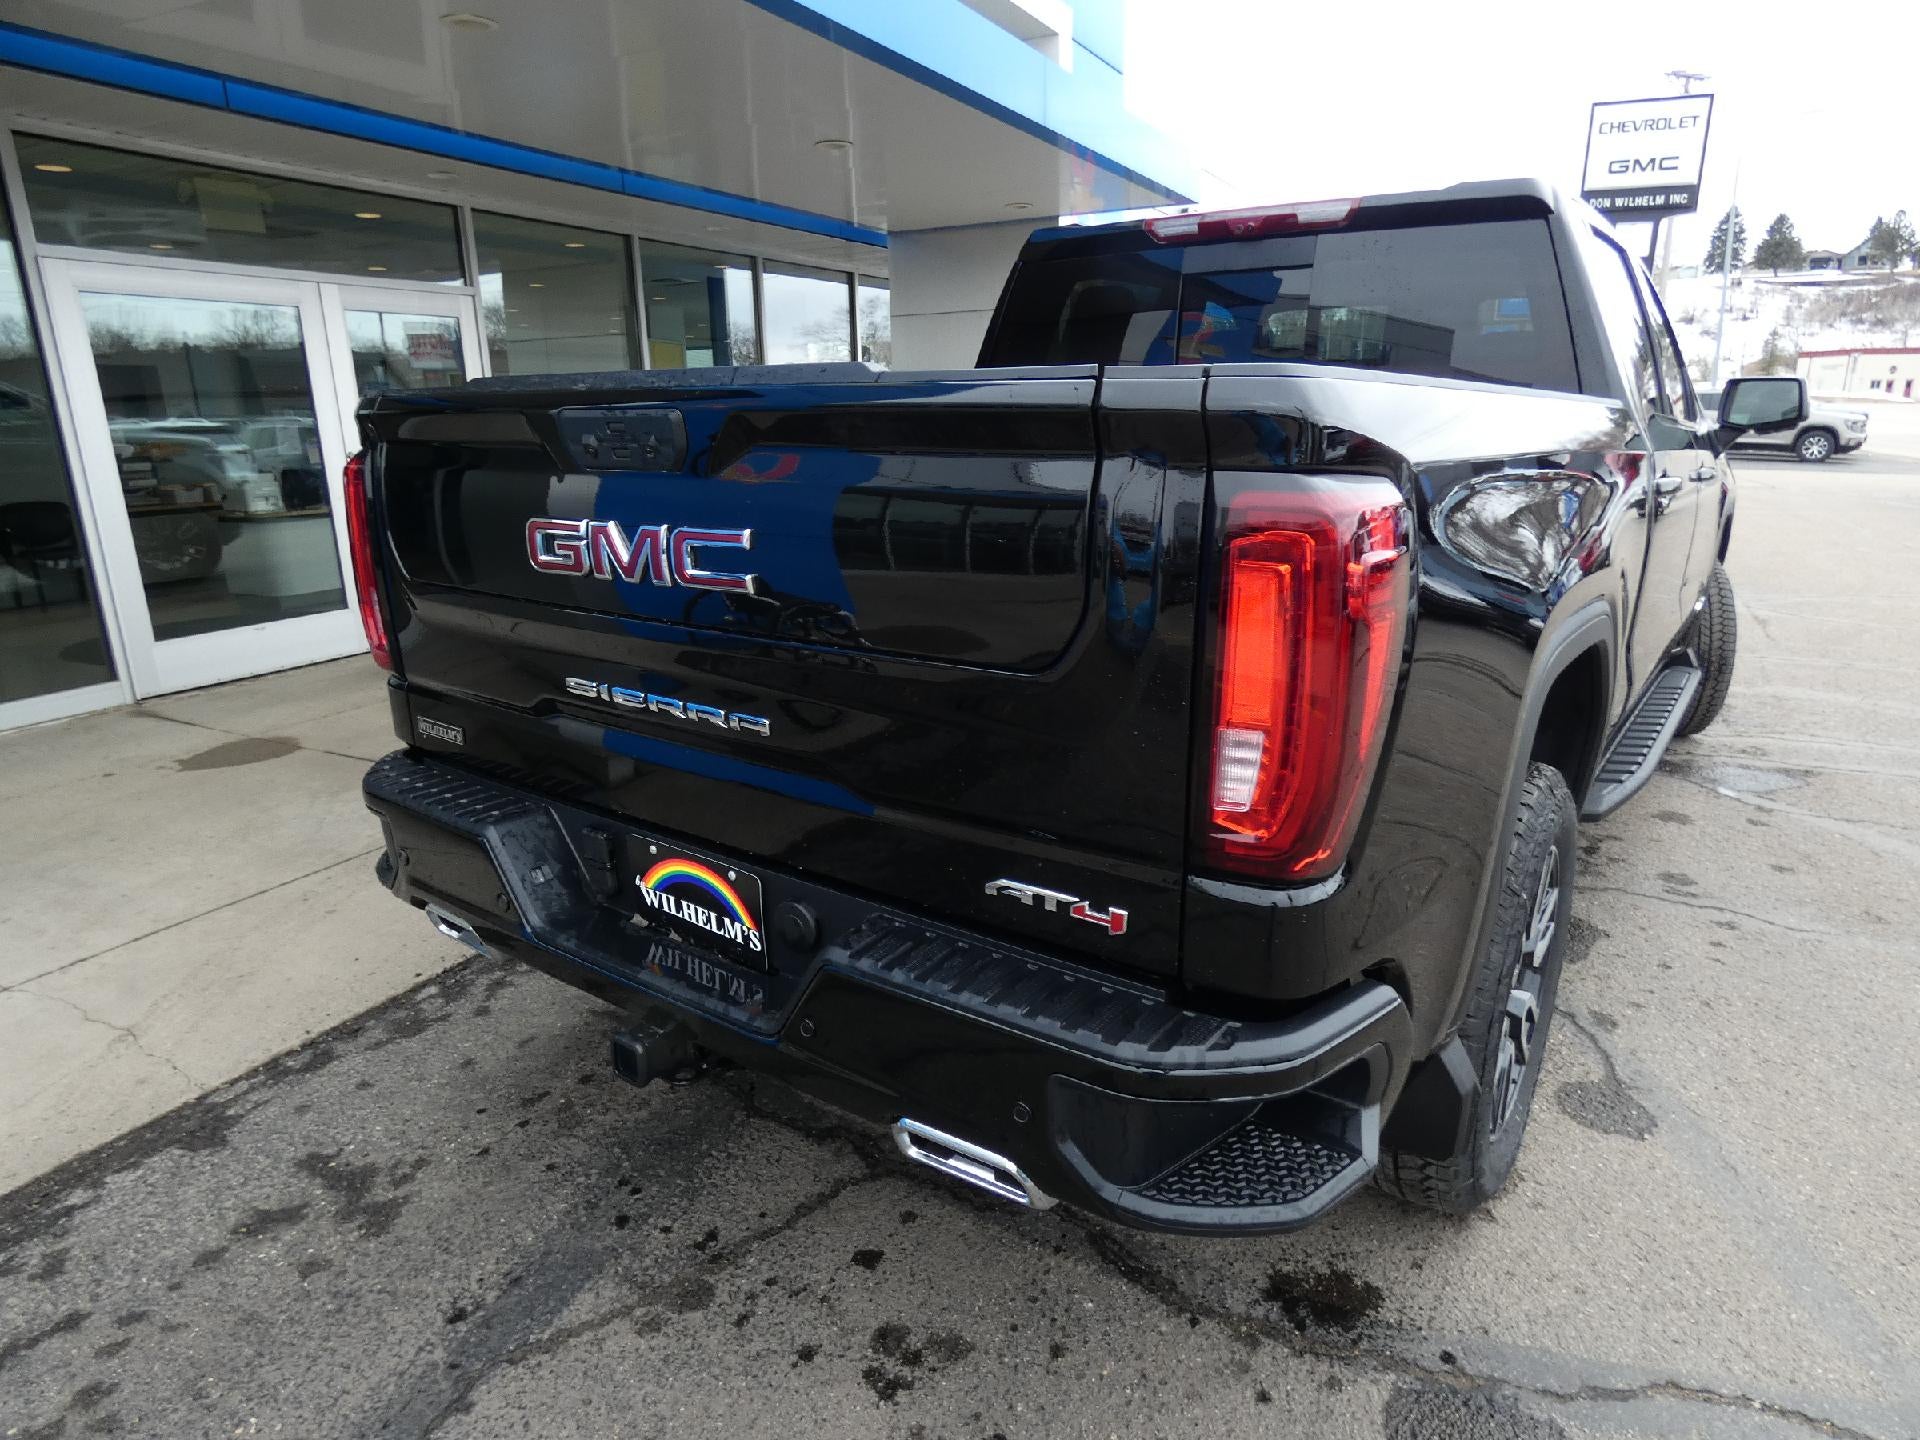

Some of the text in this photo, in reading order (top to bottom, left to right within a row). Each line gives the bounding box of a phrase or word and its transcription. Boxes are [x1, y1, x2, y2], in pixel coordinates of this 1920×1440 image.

[1599, 115, 1700, 134] CHEVROLET
[1608, 156, 1679, 174] GMC
[1589, 193, 1688, 208] DON WILHELM INC
[526, 517, 755, 594] GMC
[565, 677, 771, 737] SIERRA
[640, 885, 763, 951] WILHELM'S
[985, 878, 1129, 936] AT4
